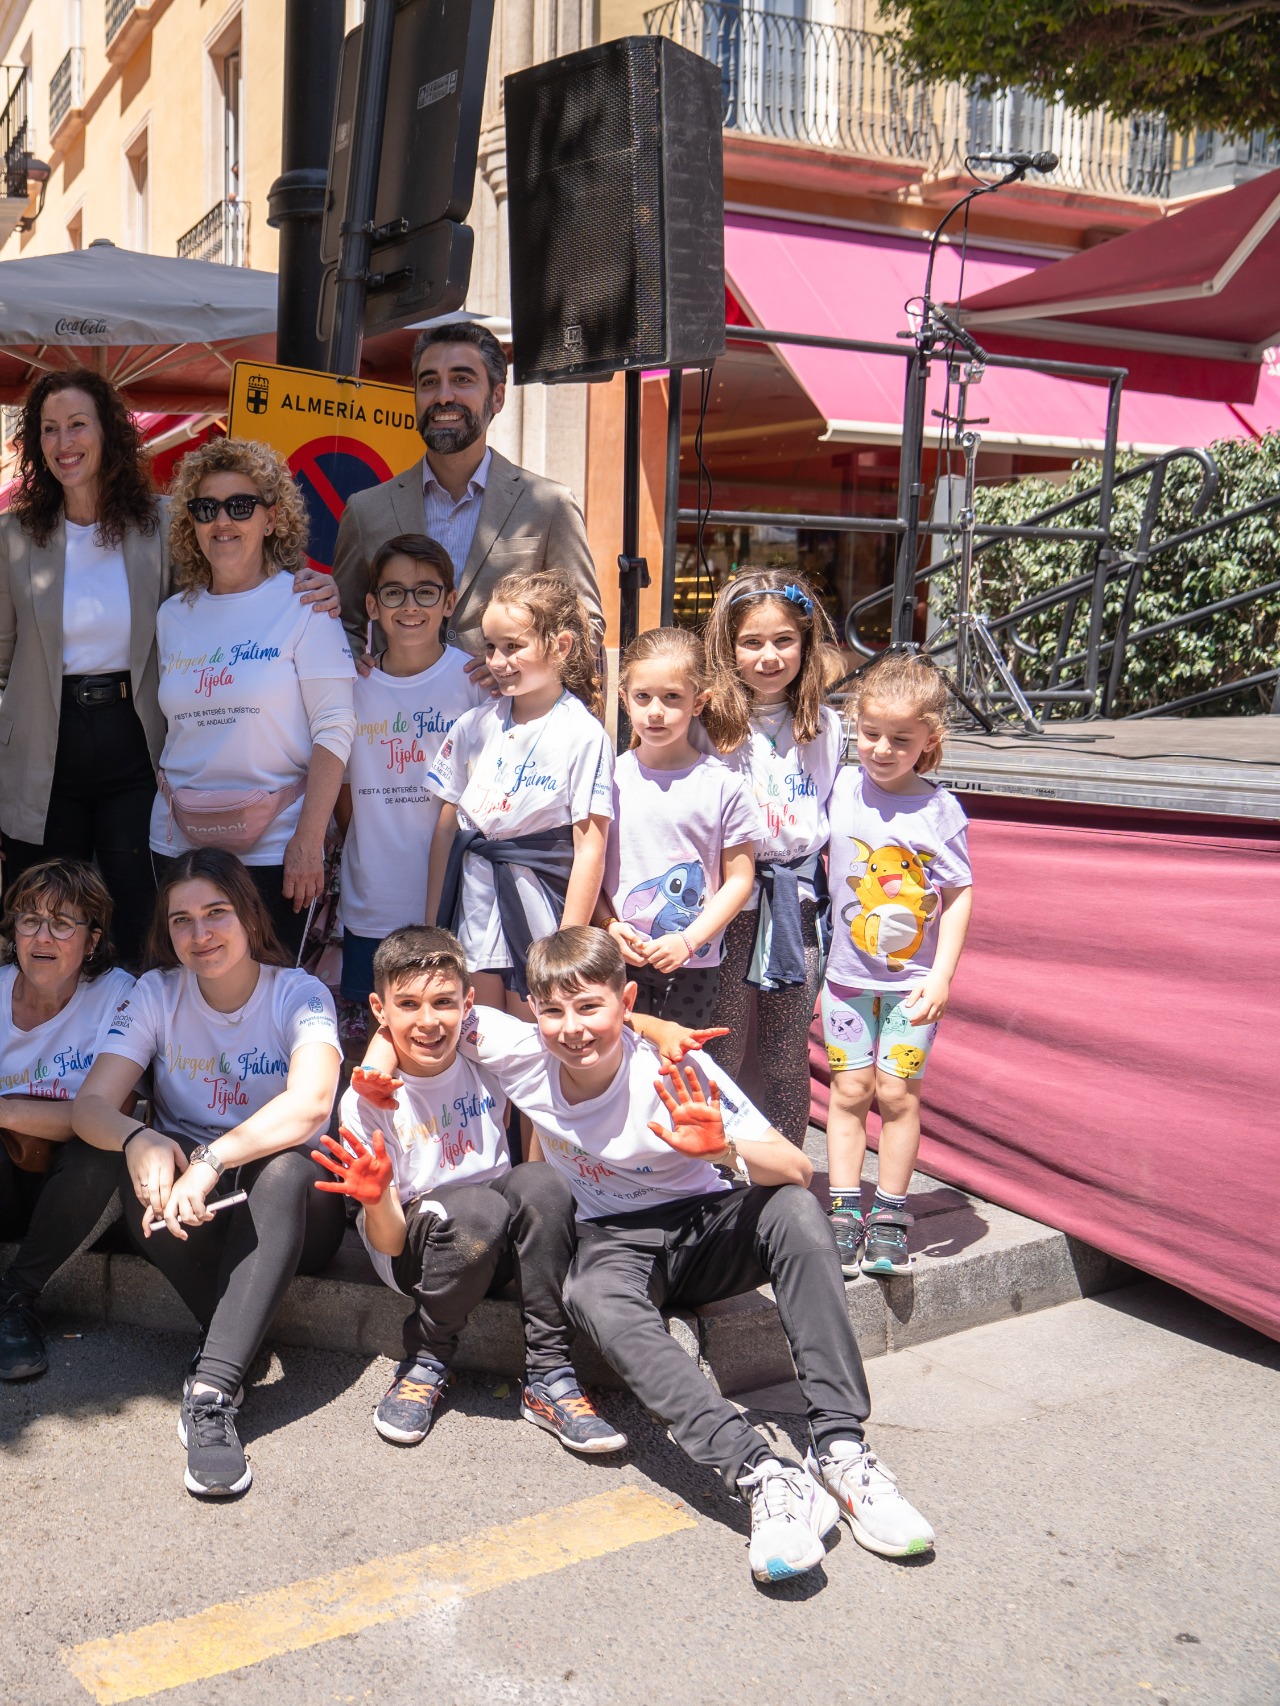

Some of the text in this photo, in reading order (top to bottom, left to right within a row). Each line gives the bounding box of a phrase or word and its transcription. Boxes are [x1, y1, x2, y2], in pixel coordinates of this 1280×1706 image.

[55, 318, 107, 336] Coca-Cola
[281, 393, 419, 432] ALMERÍA CIUD
[209, 647, 225, 664] de
[229, 640, 282, 666] Fátima
[193, 666, 235, 697] Tíjola
[202, 707, 226, 716] INTERÉS
[228, 706, 260, 714] TURÍSTICO
[206, 717, 236, 726] ANDALUCÍA
[355, 707, 457, 744] irgen de Fátim
[381, 738, 426, 774] Tíjola
[392, 786, 417, 794] INTERÉS
[784, 768, 818, 802] Fáti
[395, 795, 431, 804] ANDALUCÍA
[35, 1058, 50, 1080] de
[165, 1042, 215, 1080] Virgen
[219, 1052, 232, 1075] de
[204, 1077, 249, 1115] Tíjola
[441, 1104, 452, 1128] de
